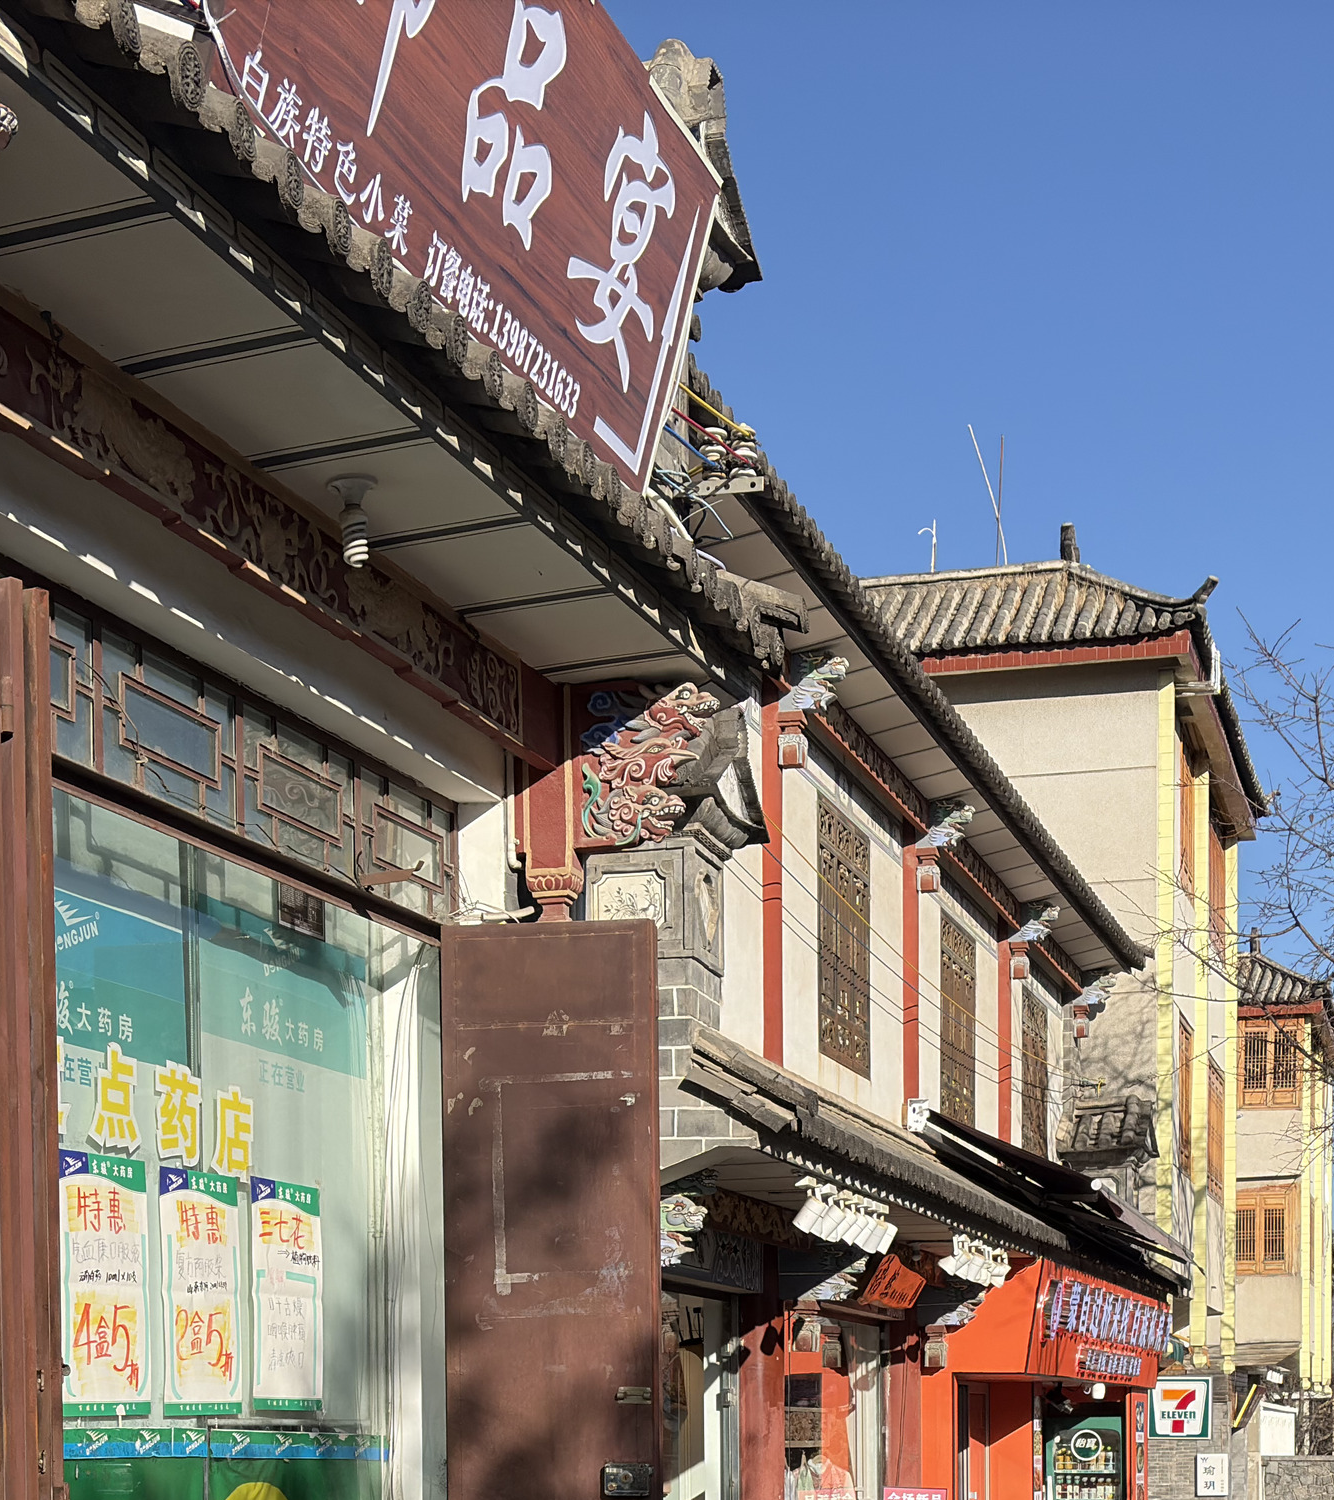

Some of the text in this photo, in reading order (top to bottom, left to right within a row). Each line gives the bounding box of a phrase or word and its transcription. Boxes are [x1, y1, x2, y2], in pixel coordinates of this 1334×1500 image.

[241, 49, 409, 256] 白族特色小菜
[57, 920, 99, 951] ONGJUN
[62, 1053, 105, 1088] 在营
[258, 1058, 305, 1094] 正在营业
[57, 1045, 255, 1174] 点药店
[77, 1186, 126, 1234] 特惠
[180, 1201, 223, 1245] 特惠
[259, 1210, 305, 1250] 三七花
